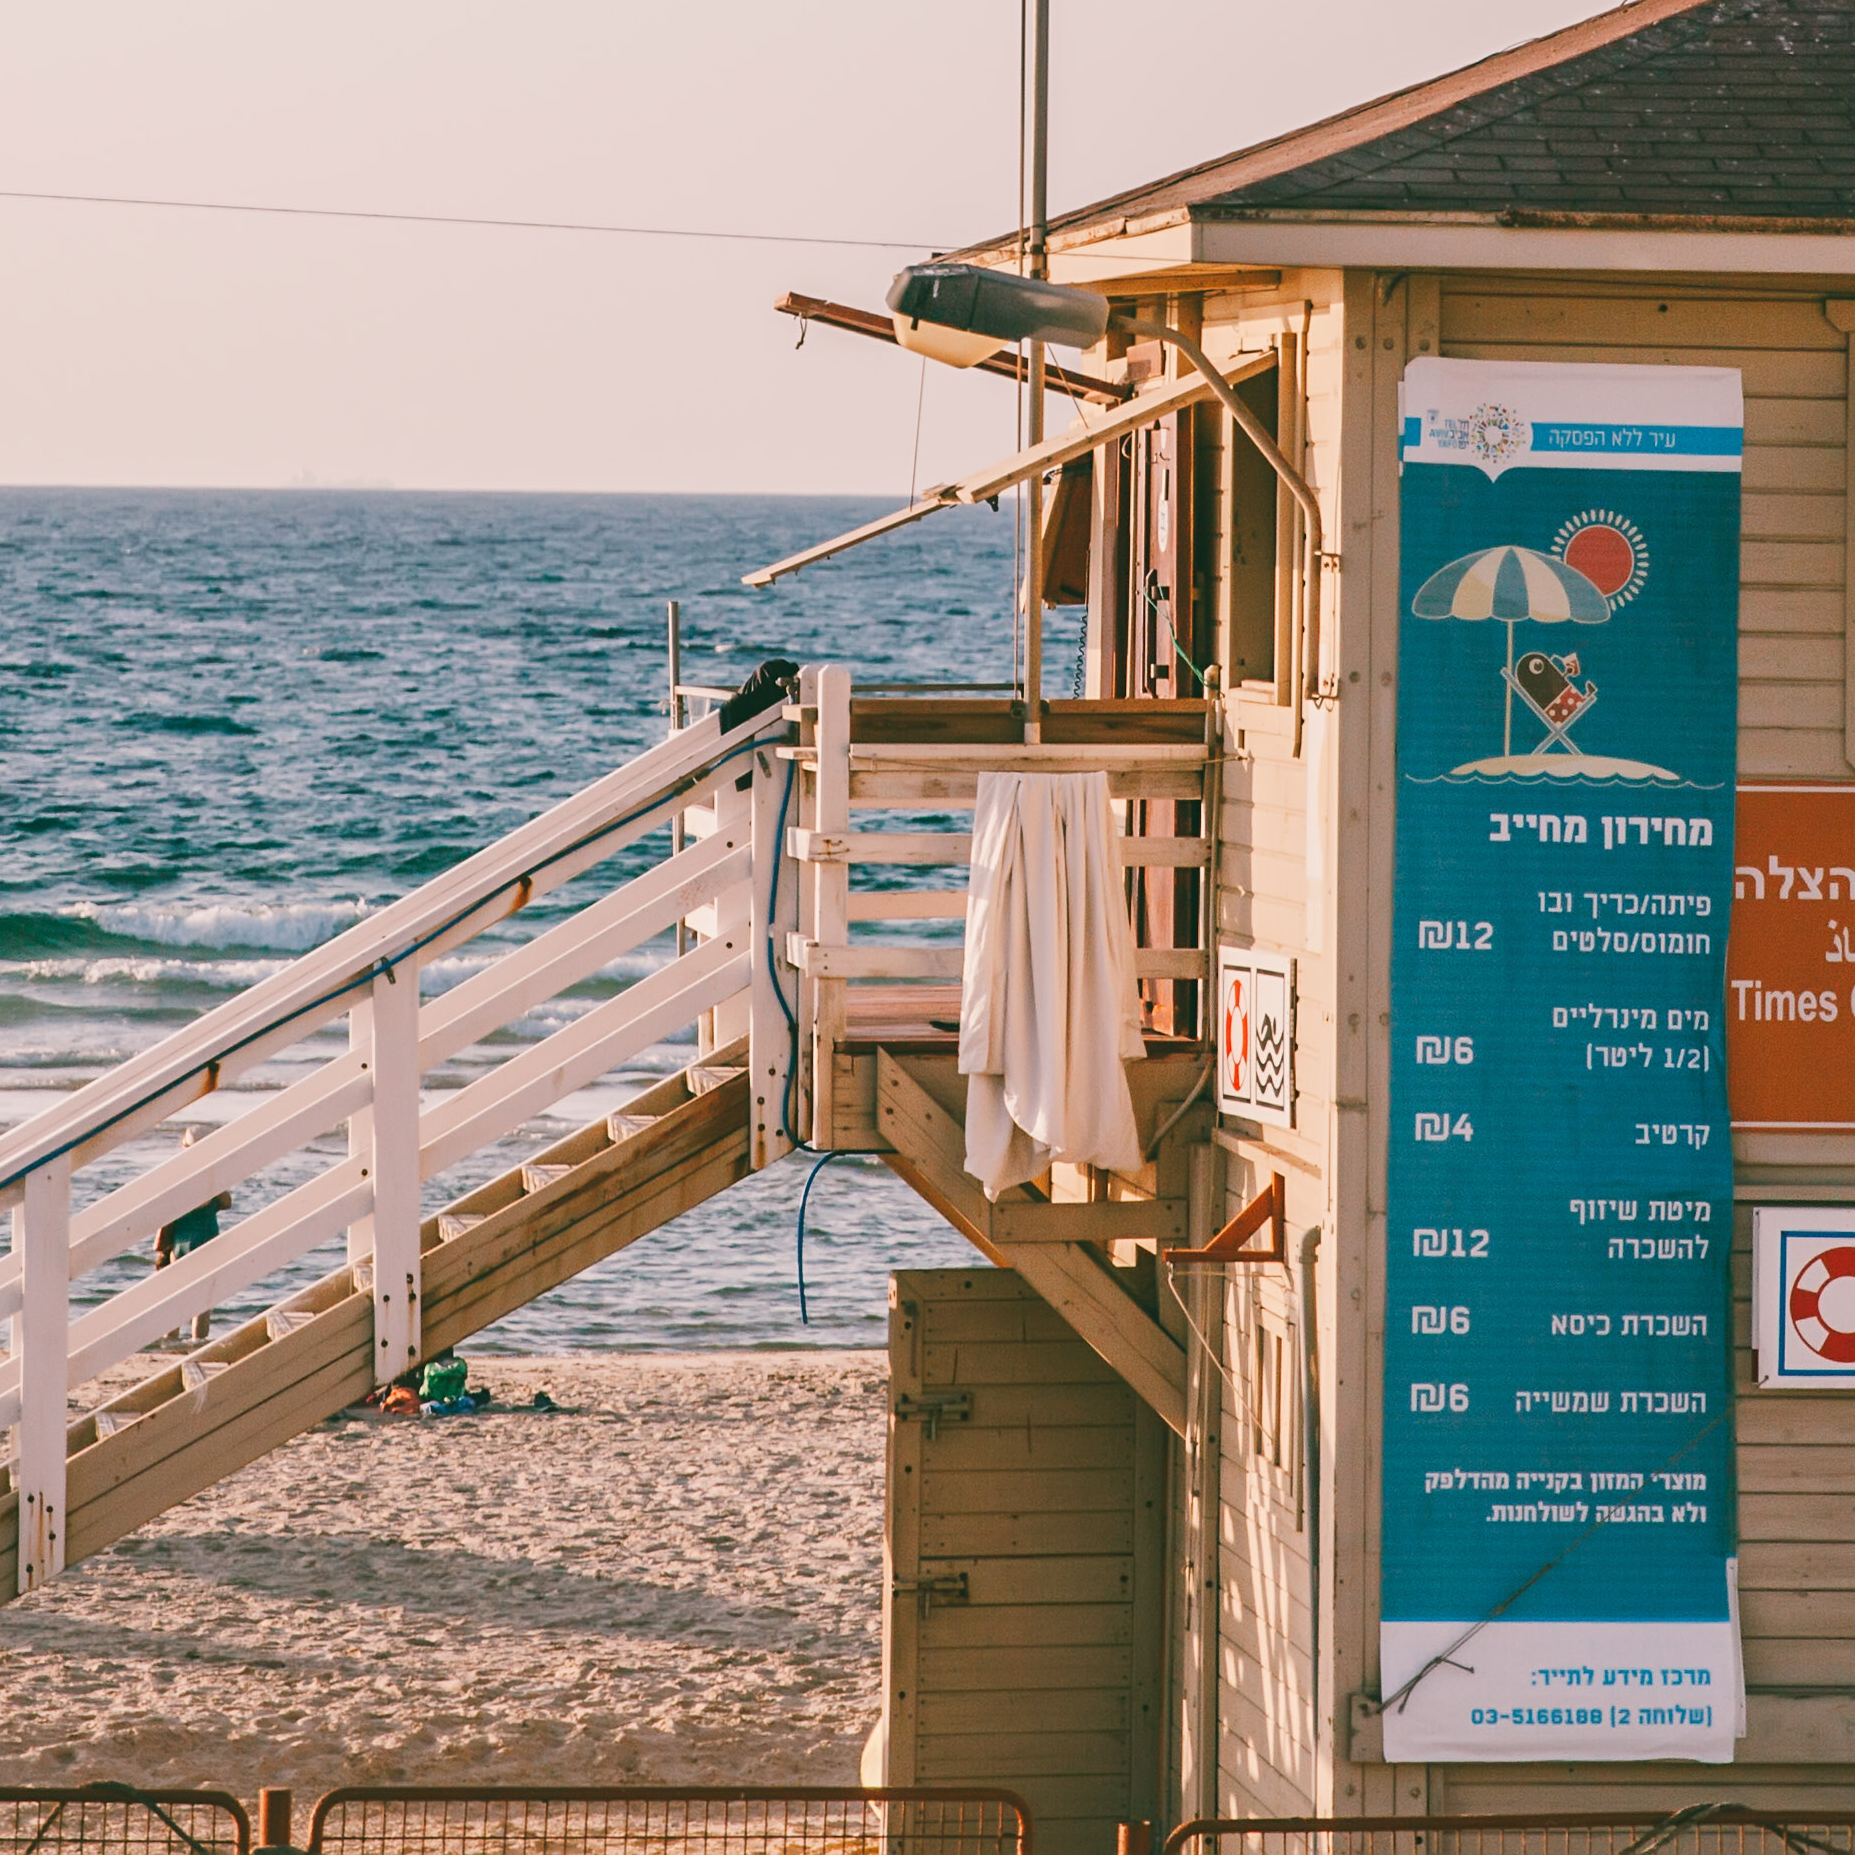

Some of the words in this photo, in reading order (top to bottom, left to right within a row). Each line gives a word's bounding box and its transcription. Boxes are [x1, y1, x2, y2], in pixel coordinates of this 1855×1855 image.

[1549, 429, 1605, 448] הפסקה
[1612, 429, 1642, 446] ללא
[1649, 432, 1675, 447] עיר
[1490, 814, 1587, 843] מחייב
[1601, 816, 1712, 849] מחירון
[1538, 892, 1572, 912] ובו
[1584, 893, 1711, 919] פיתה/כריך
[1419, 921, 1493, 949] ₪12
[1553, 927, 1710, 954] חומוס/סלטים
[1731, 980, 1838, 1022] Times
[1553, 1003, 1657, 1029] מינרליים
[1668, 1010, 1709, 1030] מים
[1416, 1036, 1473, 1064] ₪6
[1415, 1113, 1473, 1141] ₪4
[1636, 1124, 1710, 1150] קרטיב
[1570, 1199, 1637, 1225] שיזוף
[1648, 1201, 1710, 1221] מיטת
[1413, 1229, 1489, 1257] ₪12
[1609, 1235, 1708, 1259] להשכרה
[1412, 1306, 1470, 1334] ₪6
[1552, 1315, 1610, 1335] כיסא
[1621, 1315, 1707, 1335] השכרת
[1411, 1383, 1469, 1412] ₪6
[1516, 1391, 1609, 1412] שמשייה
[1620, 1392, 1706, 1413] השכרת
[1425, 1468, 1509, 1493] מהדלפק
[1516, 1472, 1582, 1493] בקנייה
[1591, 1472, 1644, 1496] המזון
[1650, 1473, 1708, 1491] מוצרי
[1486, 1501, 1589, 1522] לשולחנות.
[1596, 1504, 1664, 1523] בהגשה
[1672, 1502, 1706, 1522] ולא
[1532, 1666, 1594, 1685] לתייר:
[1603, 1669, 1653, 1685] מידע
[1661, 1669, 1710, 1685] מרכז
[1472, 1709, 1602, 1724] 03-5166188
[1639, 1705, 1712, 1727] (שלוחה
